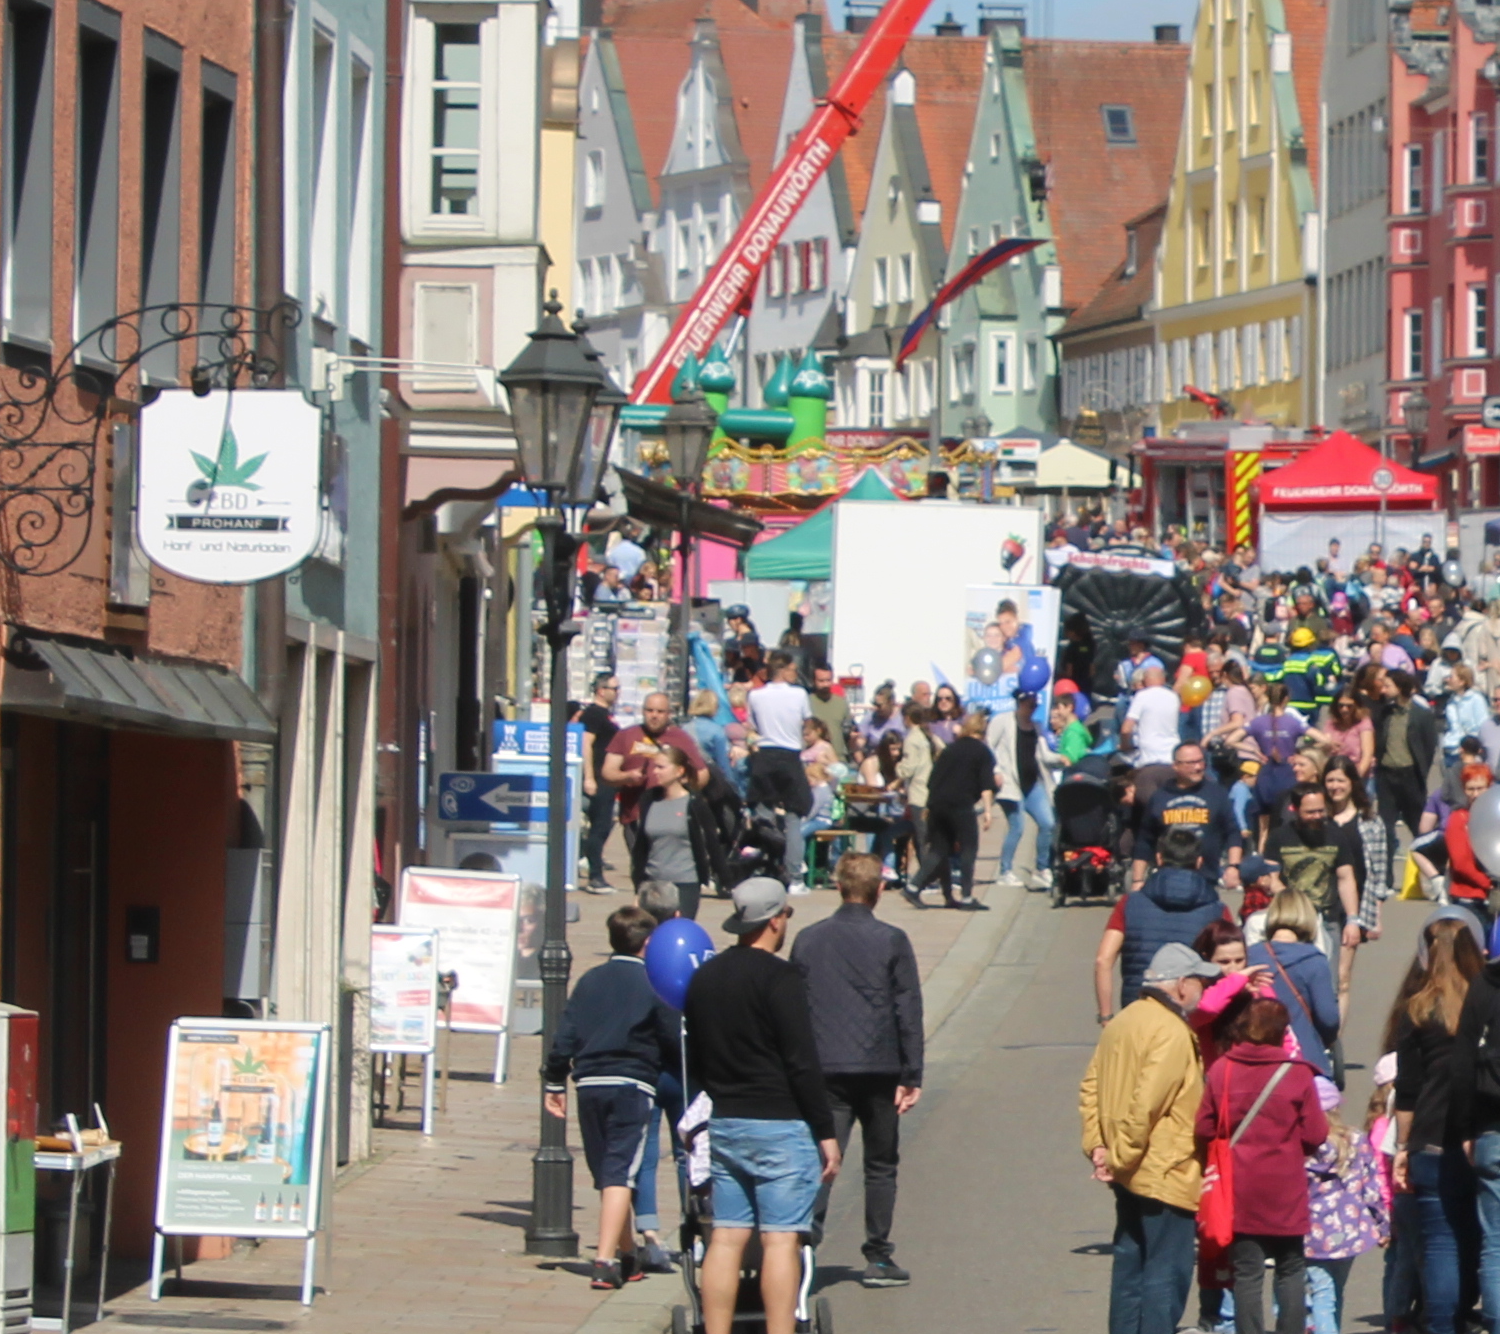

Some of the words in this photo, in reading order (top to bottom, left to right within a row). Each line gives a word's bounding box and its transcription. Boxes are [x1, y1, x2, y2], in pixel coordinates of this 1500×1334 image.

[742, 138, 831, 265] DONAUWÖRTH
[1272, 485, 1342, 498] FEUERWEHR
[191, 518, 263, 529] PROHANF
[200, 542, 222, 552] und
[226, 541, 291, 554] Naturladen
[1162, 808, 1210, 825] VINTAGE
